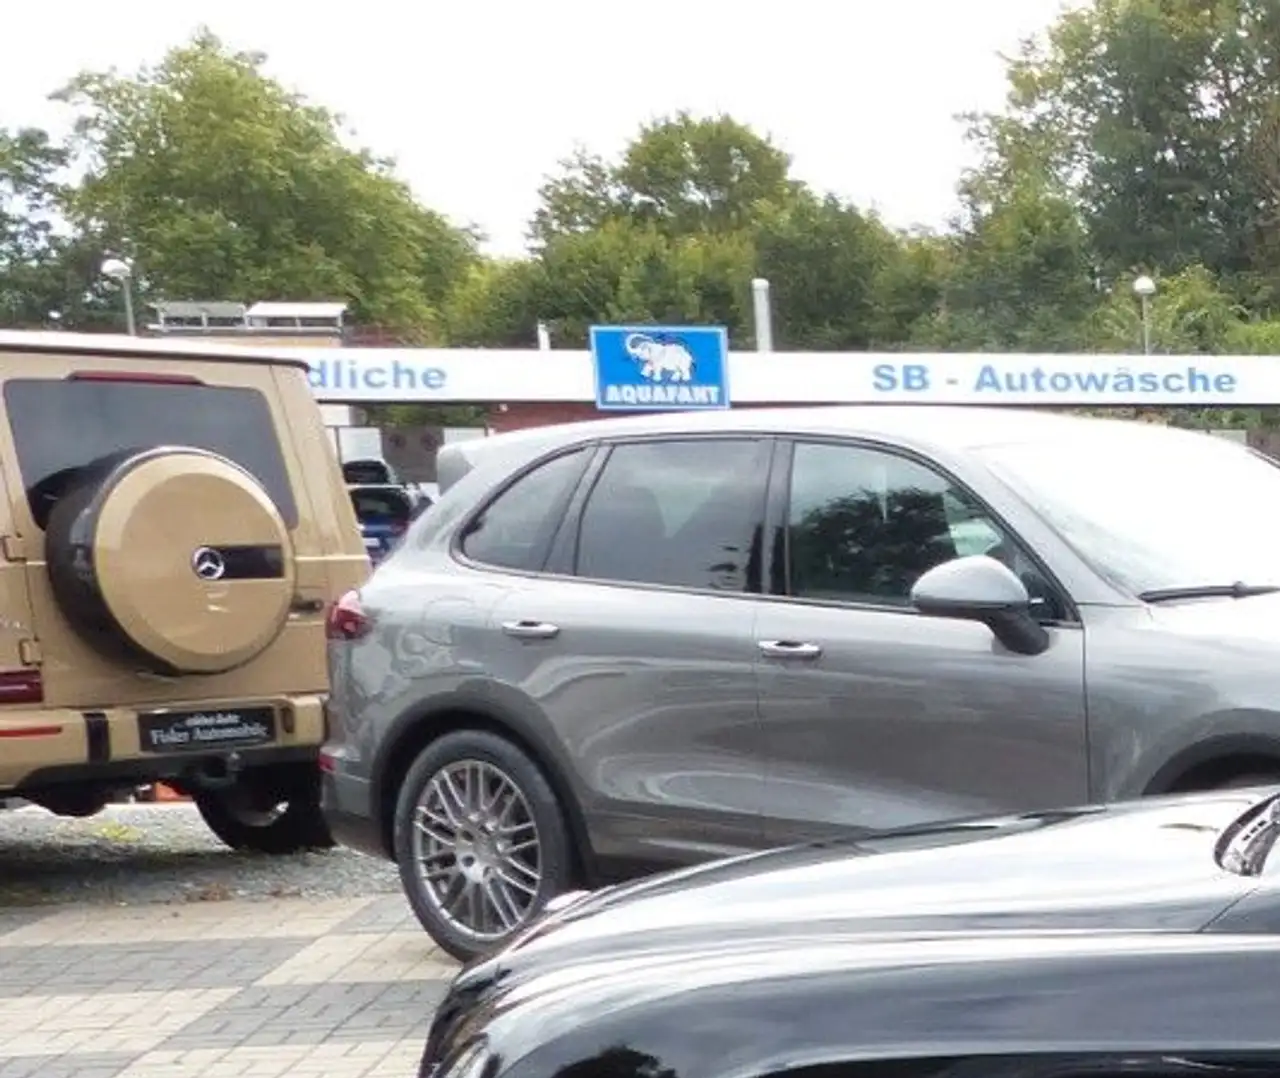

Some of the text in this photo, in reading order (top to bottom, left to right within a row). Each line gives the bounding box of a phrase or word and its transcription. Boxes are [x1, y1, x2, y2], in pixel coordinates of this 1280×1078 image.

[873, 364, 930, 392] SB
[974, 364, 1238, 393] Autowäsche
[605, 383, 721, 405] AQUAFANT
